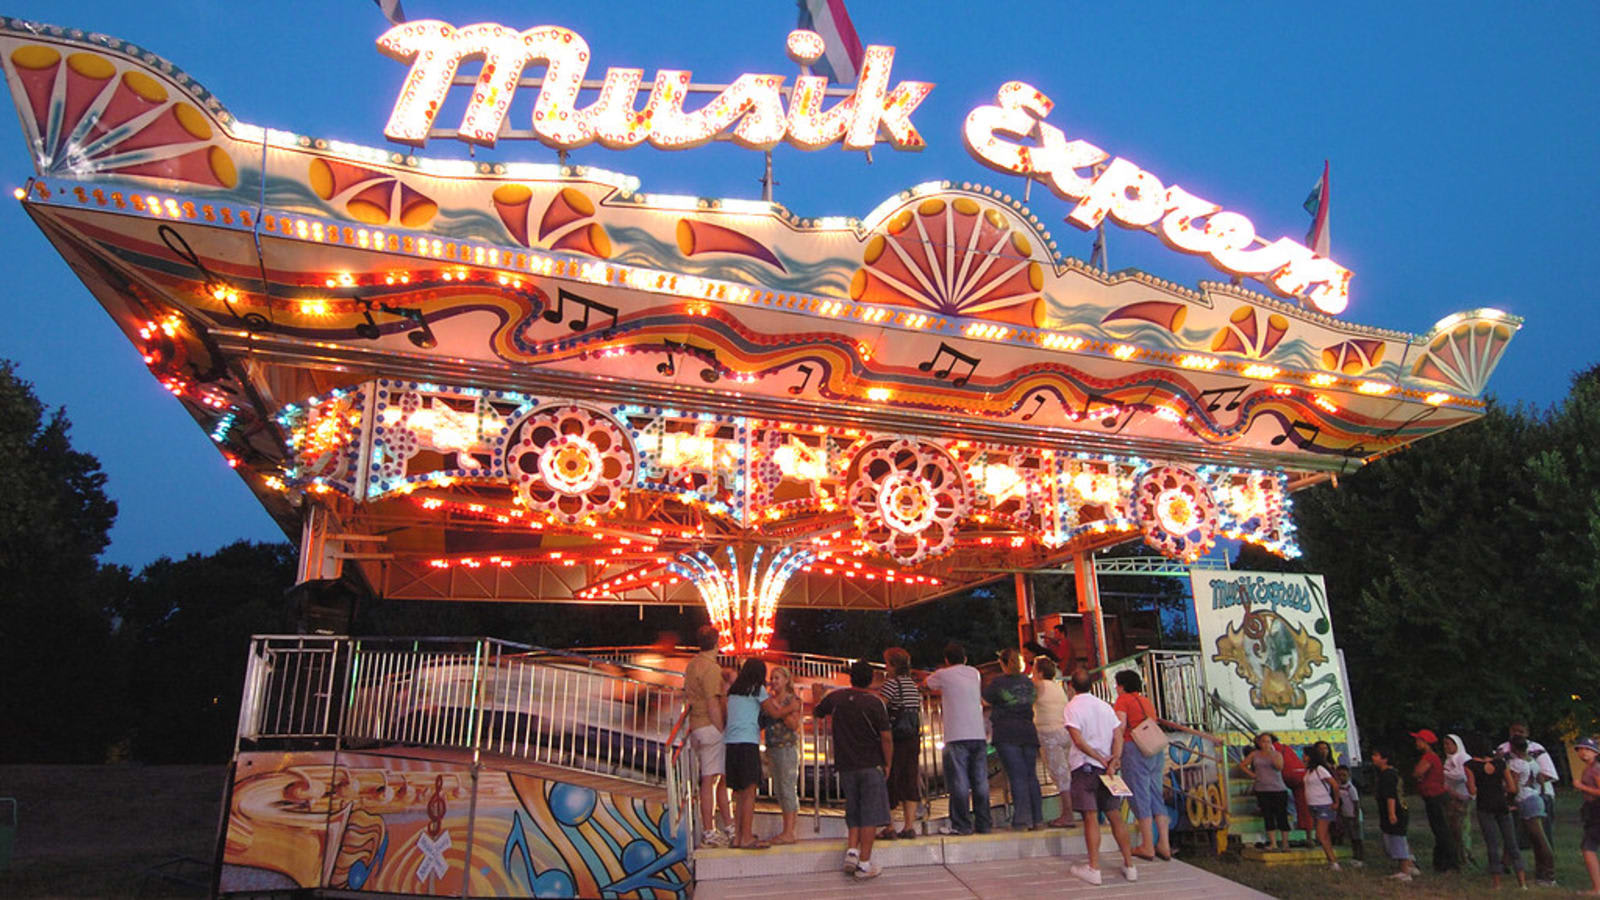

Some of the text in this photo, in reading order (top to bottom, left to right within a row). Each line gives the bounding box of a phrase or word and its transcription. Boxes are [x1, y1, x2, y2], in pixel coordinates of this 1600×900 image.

[376, 19, 1355, 315] Musik Express
[1256, 576, 1311, 613] Express
